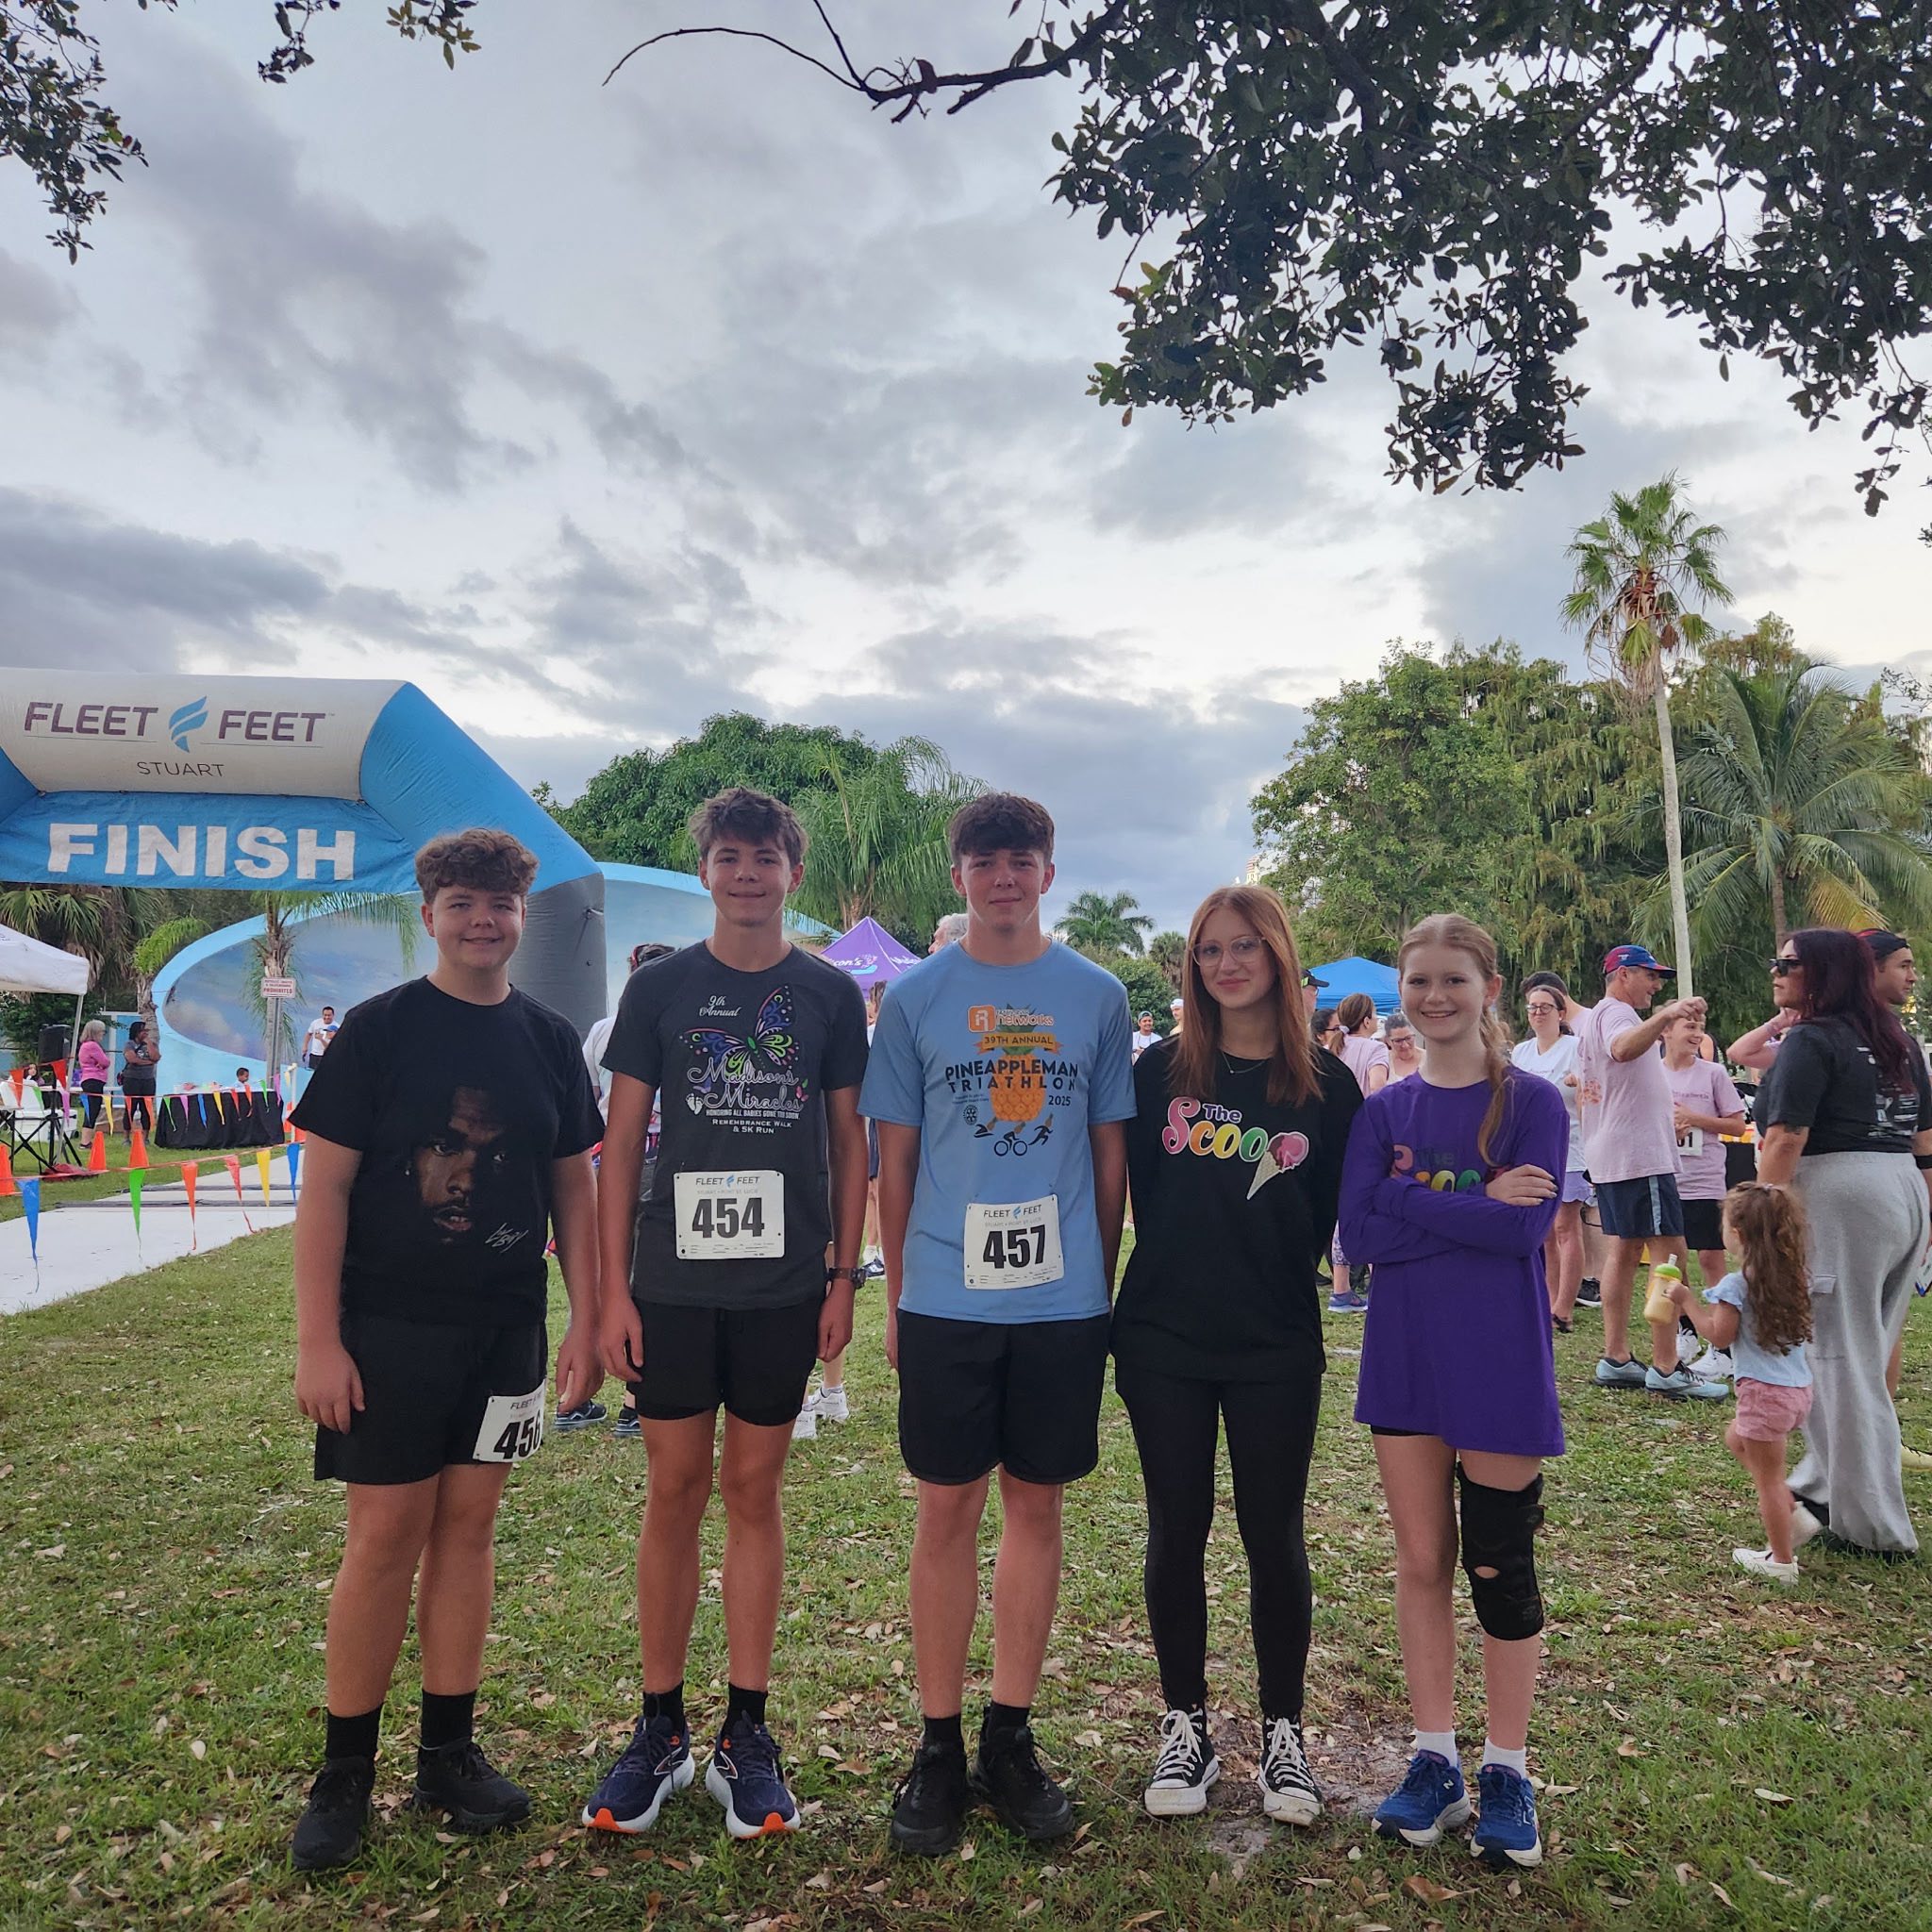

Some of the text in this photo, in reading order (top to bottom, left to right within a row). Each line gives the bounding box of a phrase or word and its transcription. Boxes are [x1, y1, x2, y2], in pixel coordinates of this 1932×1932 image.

[24, 701, 326, 742] FLEET FEET
[137, 761, 225, 778] STUART
[47, 823, 357, 881] FINISH
[699, 1006, 742, 1017] Annual
[984, 1036, 1054, 1044] 39TH ANNUAL
[687, 1057, 800, 1085] Madison's
[945, 1058, 1078, 1081] PINEAPPLEMAN
[947, 1075, 1076, 1093] TRIATHLON
[703, 1084, 804, 1112] Miracles
[1048, 1094, 1072, 1107] 2025
[1202, 1103, 1242, 1124] The
[695, 1176, 760, 1186] FLEET FEET
[691, 1197, 765, 1239] 454
[983, 1204, 1042, 1218] FLEET FEET
[982, 1224, 1046, 1269] 457
